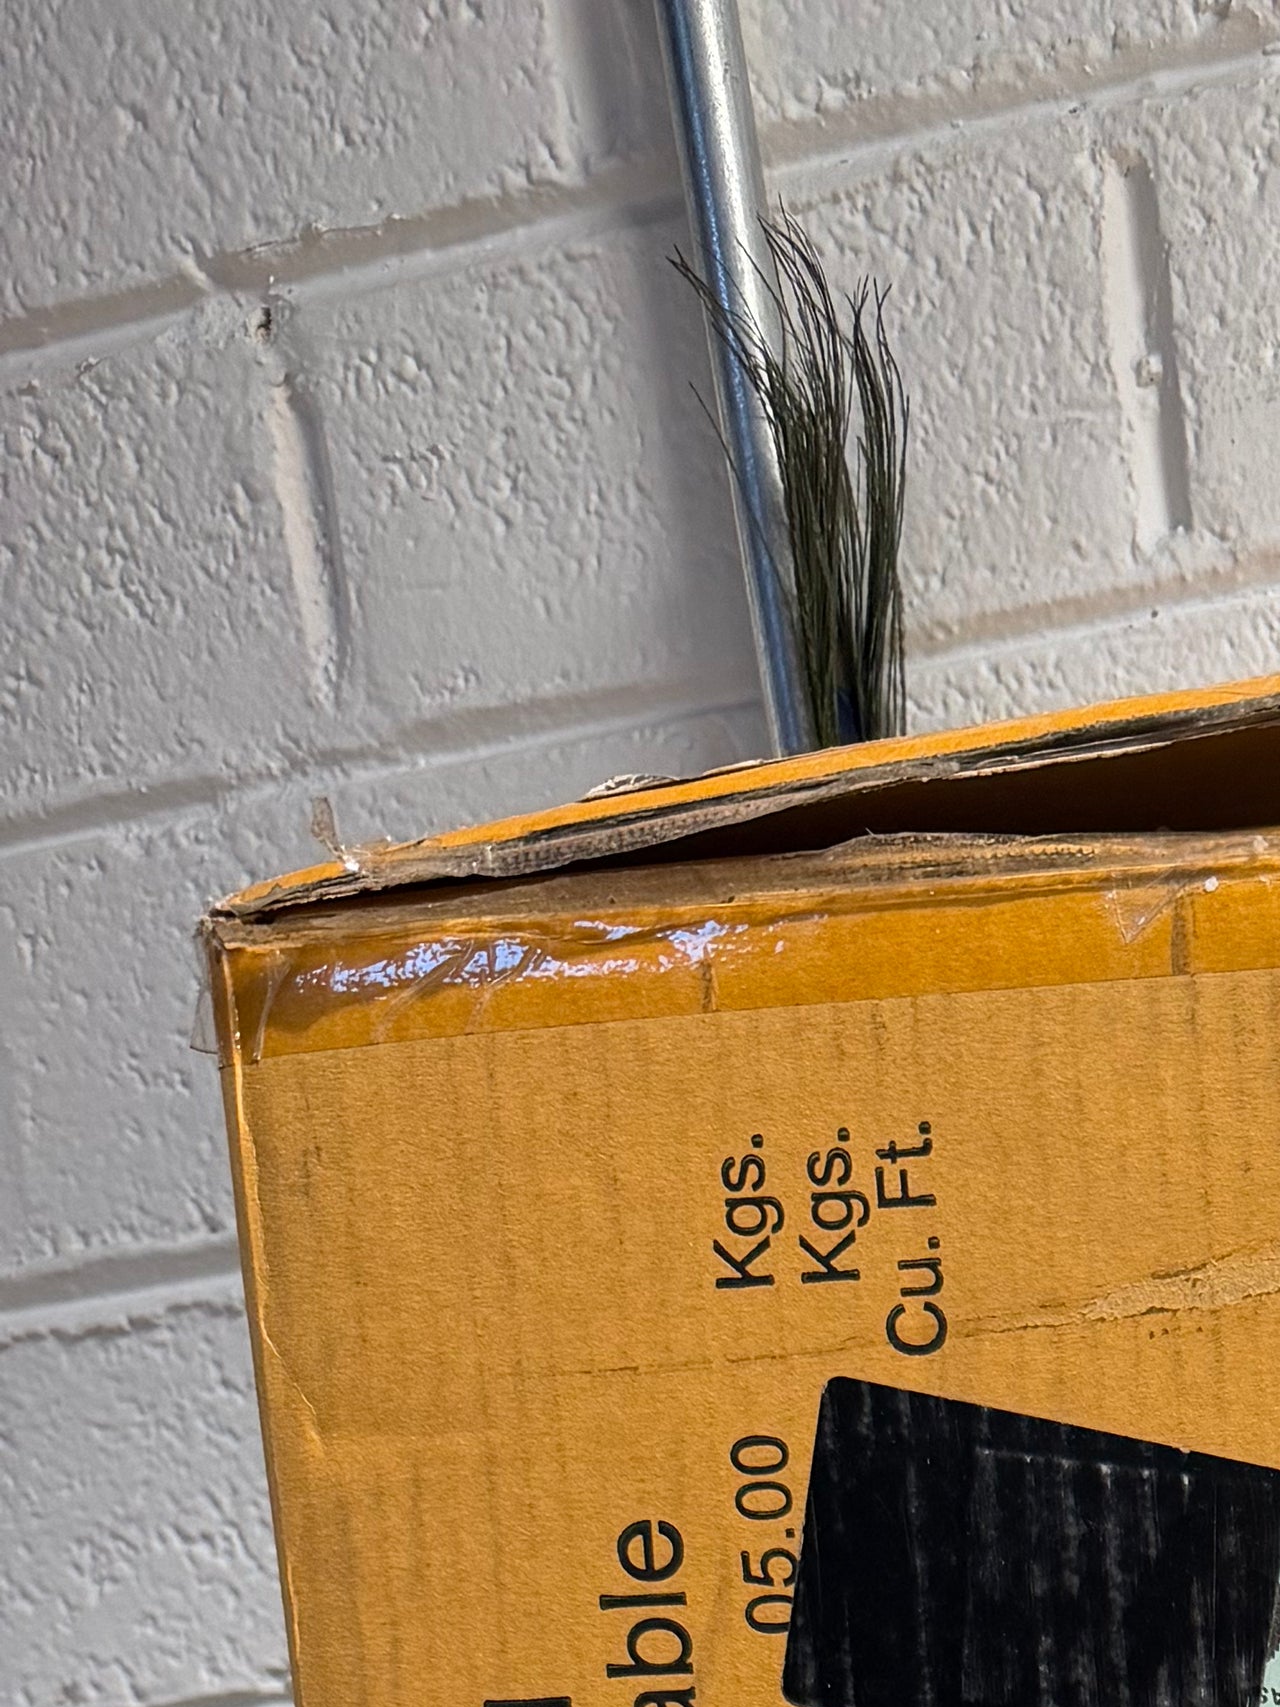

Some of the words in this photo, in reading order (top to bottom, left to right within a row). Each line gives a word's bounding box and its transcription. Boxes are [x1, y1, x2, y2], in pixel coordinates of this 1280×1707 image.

[713, 1134, 784, 1289] Kgs.
[799, 1127, 870, 1284] Kgs.
[875, 1121, 936, 1208] Ft.
[886, 1236, 947, 1355] Cu.
